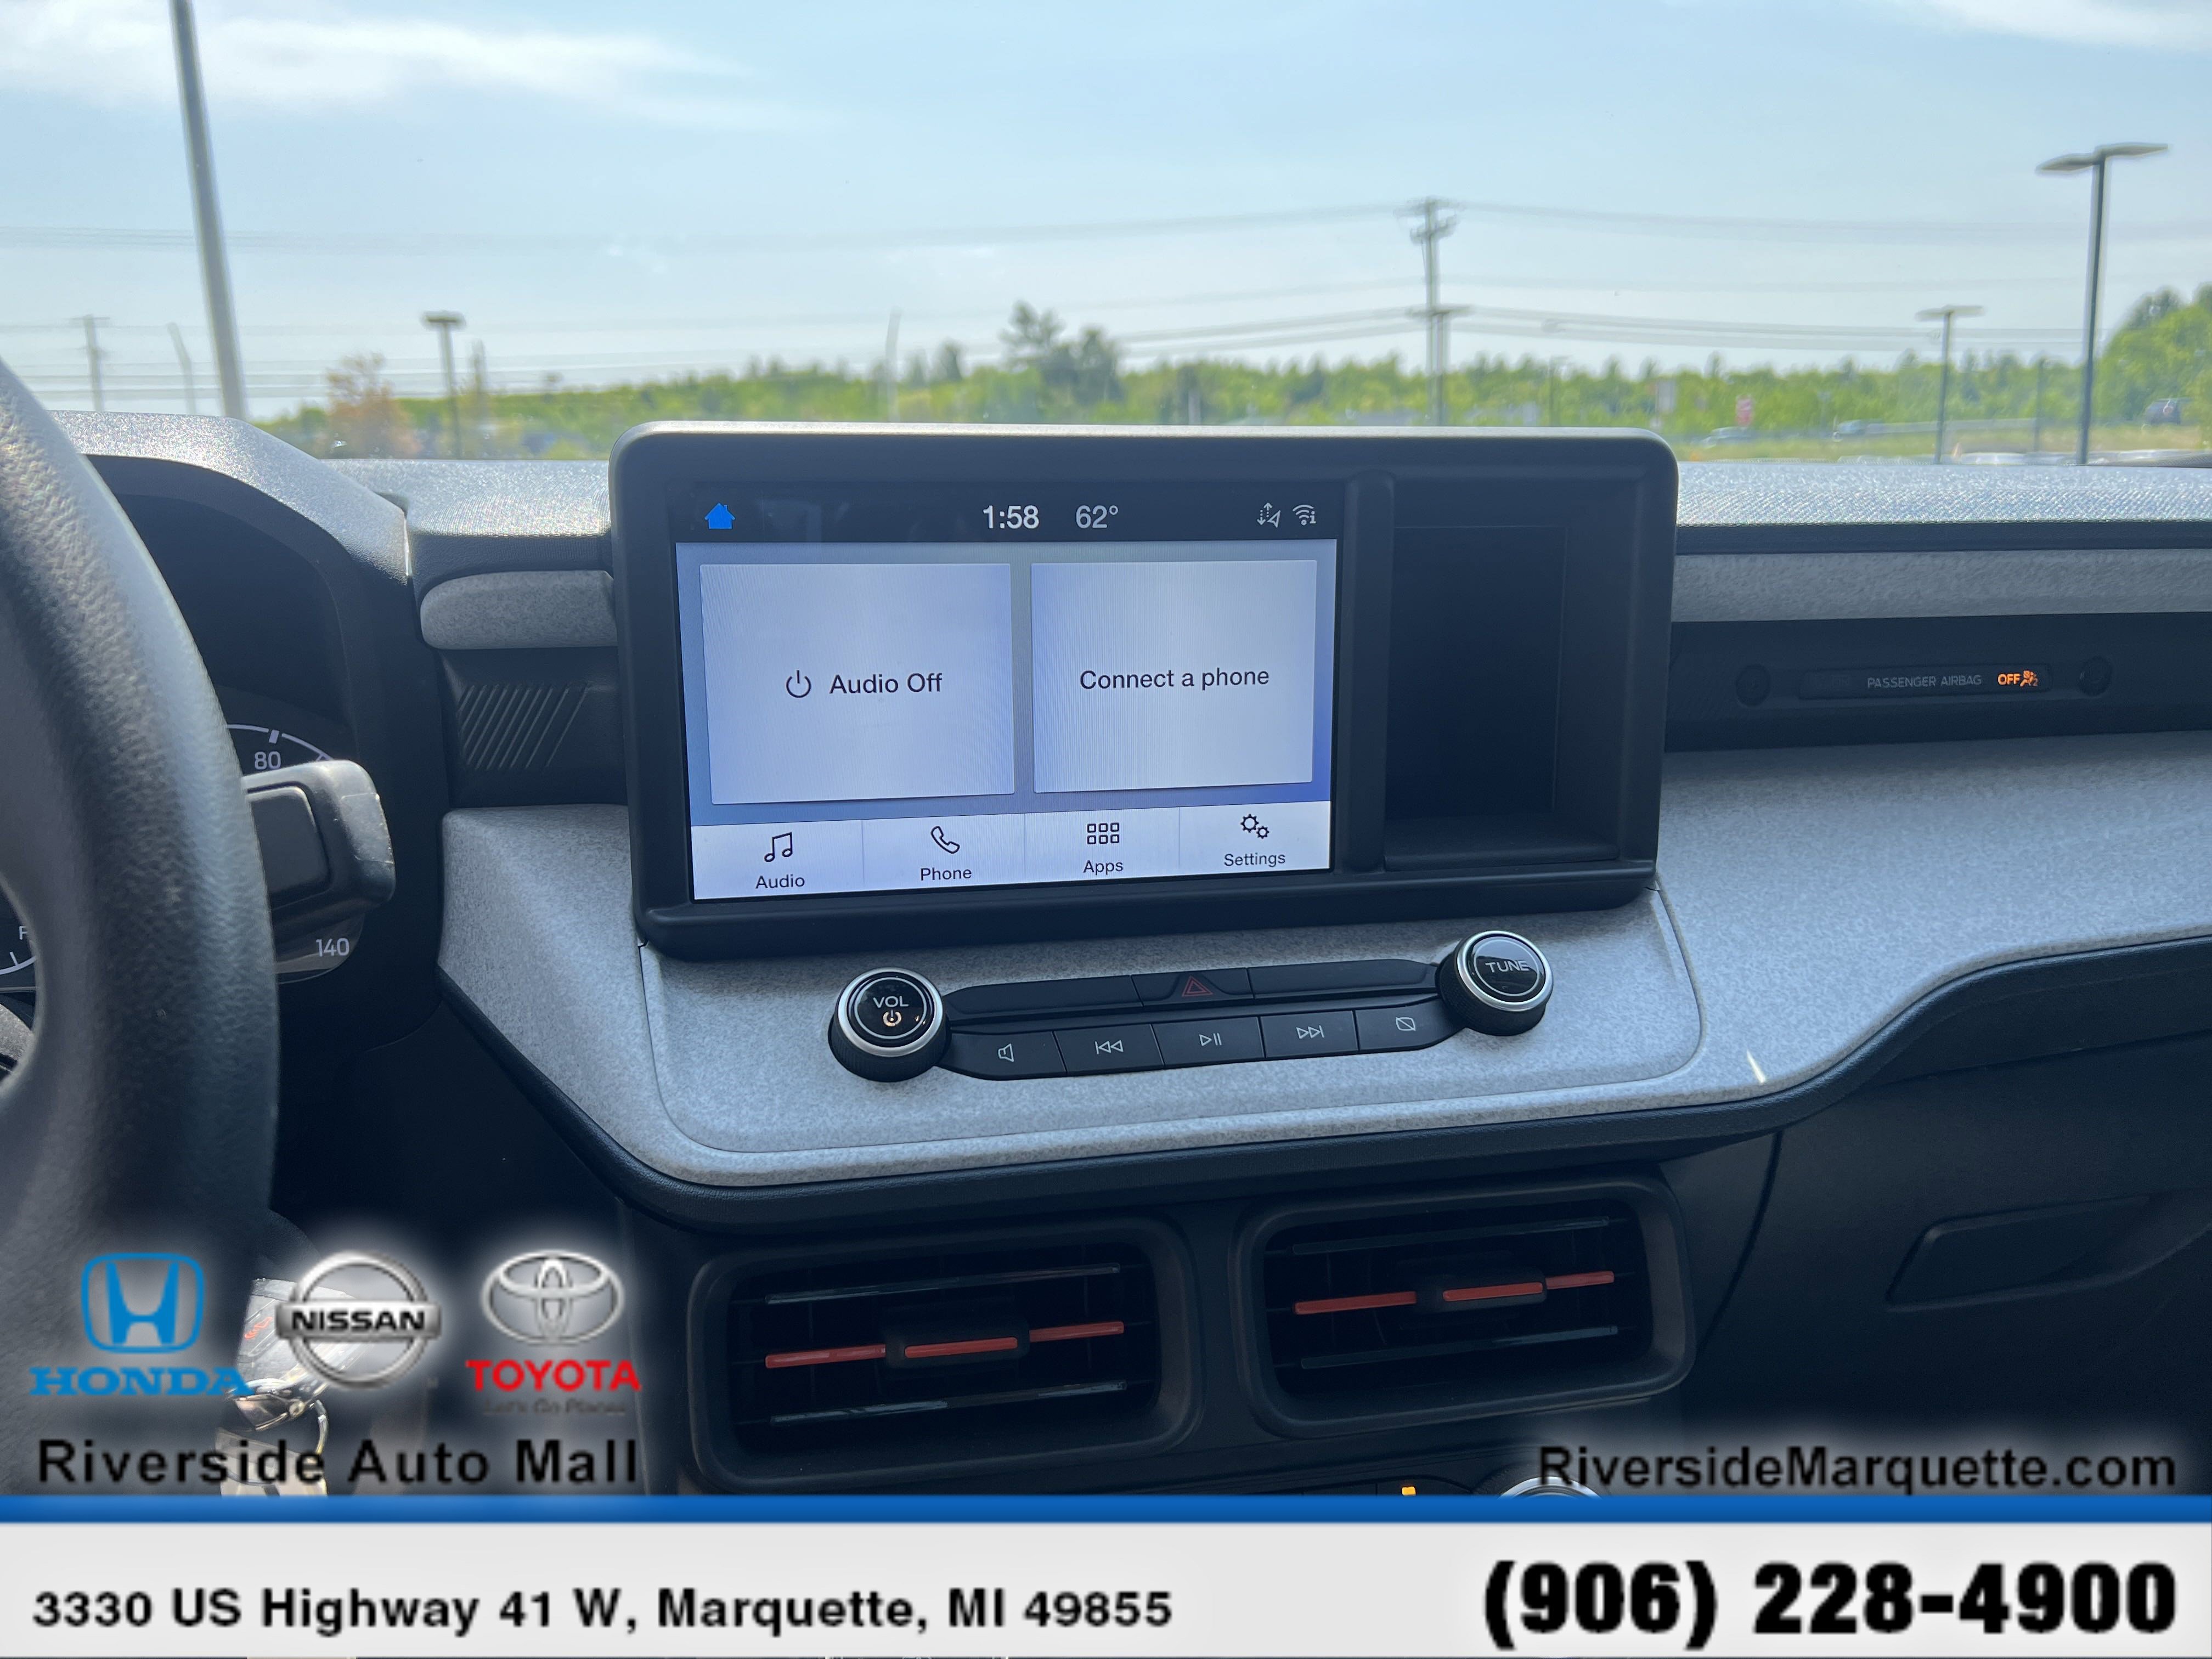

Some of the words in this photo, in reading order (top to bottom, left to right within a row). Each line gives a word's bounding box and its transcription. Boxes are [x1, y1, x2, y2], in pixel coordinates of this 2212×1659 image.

[983, 505, 1039, 529] 1:58
[1075, 505, 1119, 529] 62°
[829, 672, 899, 696] Audio
[906, 672, 943, 695] Off
[1079, 668, 1175, 690] Connect
[1181, 673, 1196, 689] a
[1201, 667, 1270, 693] phone
[1867, 675, 1937, 689] PASSENGER
[1940, 675, 1983, 687] AIRBAG
[1997, 673, 2020, 686] OFF
[254, 751, 282, 770] 80
[1082, 858, 1124, 876] Apps
[1223, 850, 1286, 869] Settings
[755, 872, 806, 890] Audio
[919, 865, 973, 882] Phone
[315, 938, 350, 957] 140
[1485, 960, 1530, 973] TUNE
[873, 996, 909, 1008] VOL
